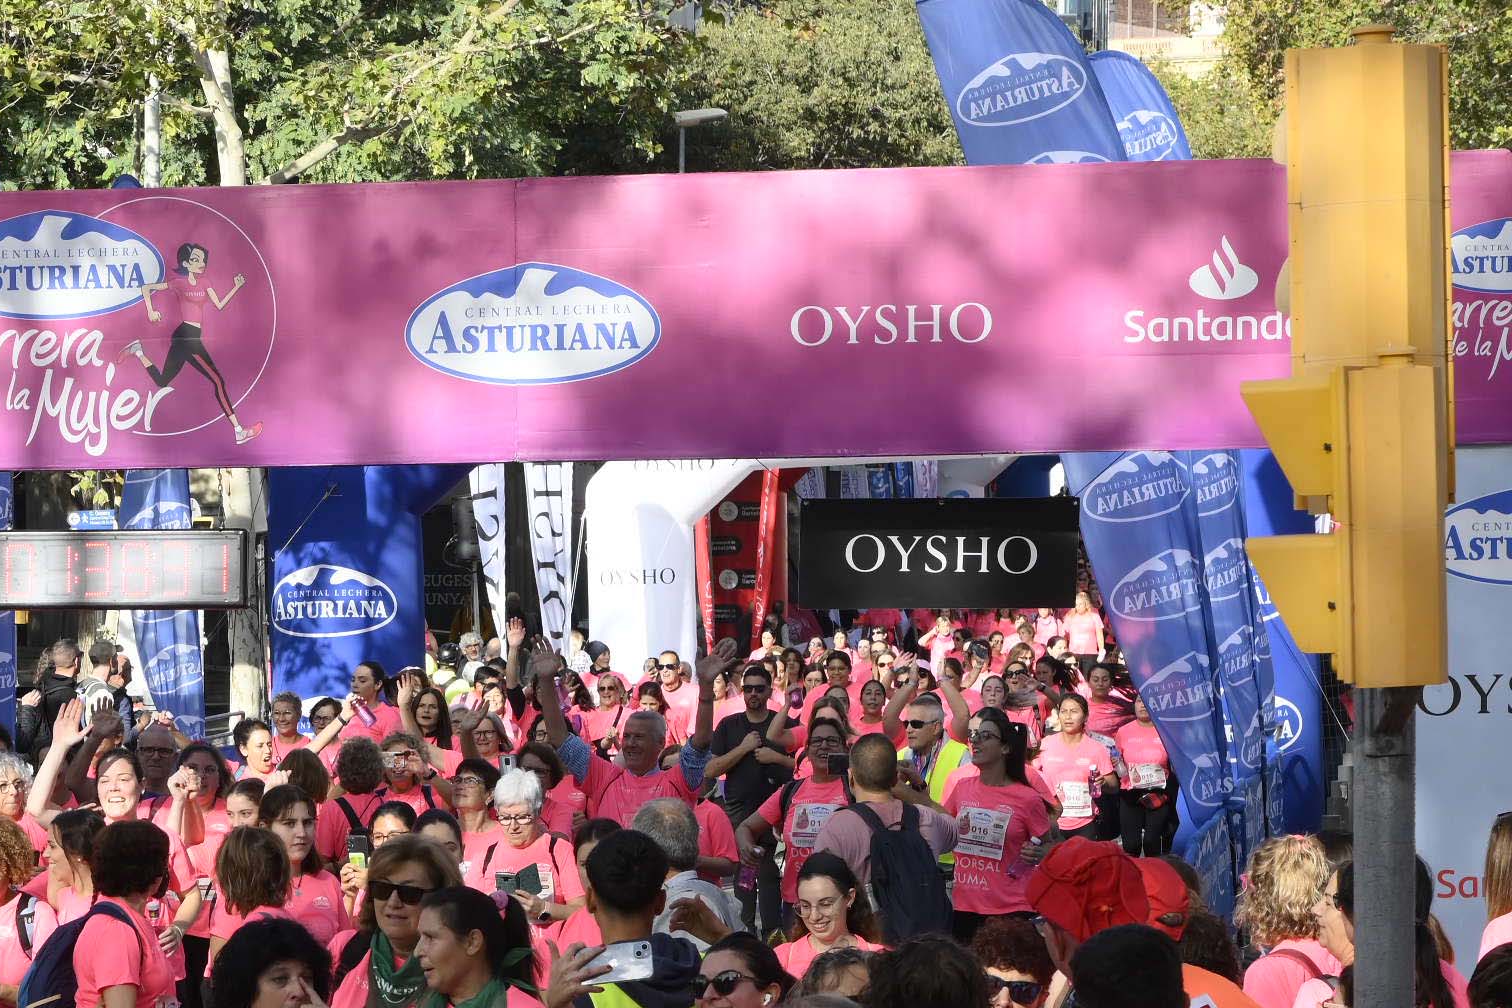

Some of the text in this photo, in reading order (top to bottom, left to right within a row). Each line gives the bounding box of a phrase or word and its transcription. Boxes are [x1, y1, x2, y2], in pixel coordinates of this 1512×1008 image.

[67, 247, 139, 258] LECHERA
[464, 303, 632, 318] CENTRAL LECHERA
[425, 310, 641, 354] ASTURIANA
[790, 302, 993, 346] OYSHO
[5, 370, 30, 411] la
[25, 363, 175, 457] Mujer
[1471, 521, 1512, 532] CENT
[844, 533, 1038, 575] OYSHO
[599, 567, 675, 586] OYSHO
[286, 588, 384, 598] CENTRAL LECHERA
[275, 594, 388, 622] ASTURIANA
[971, 826, 989, 836] 016
